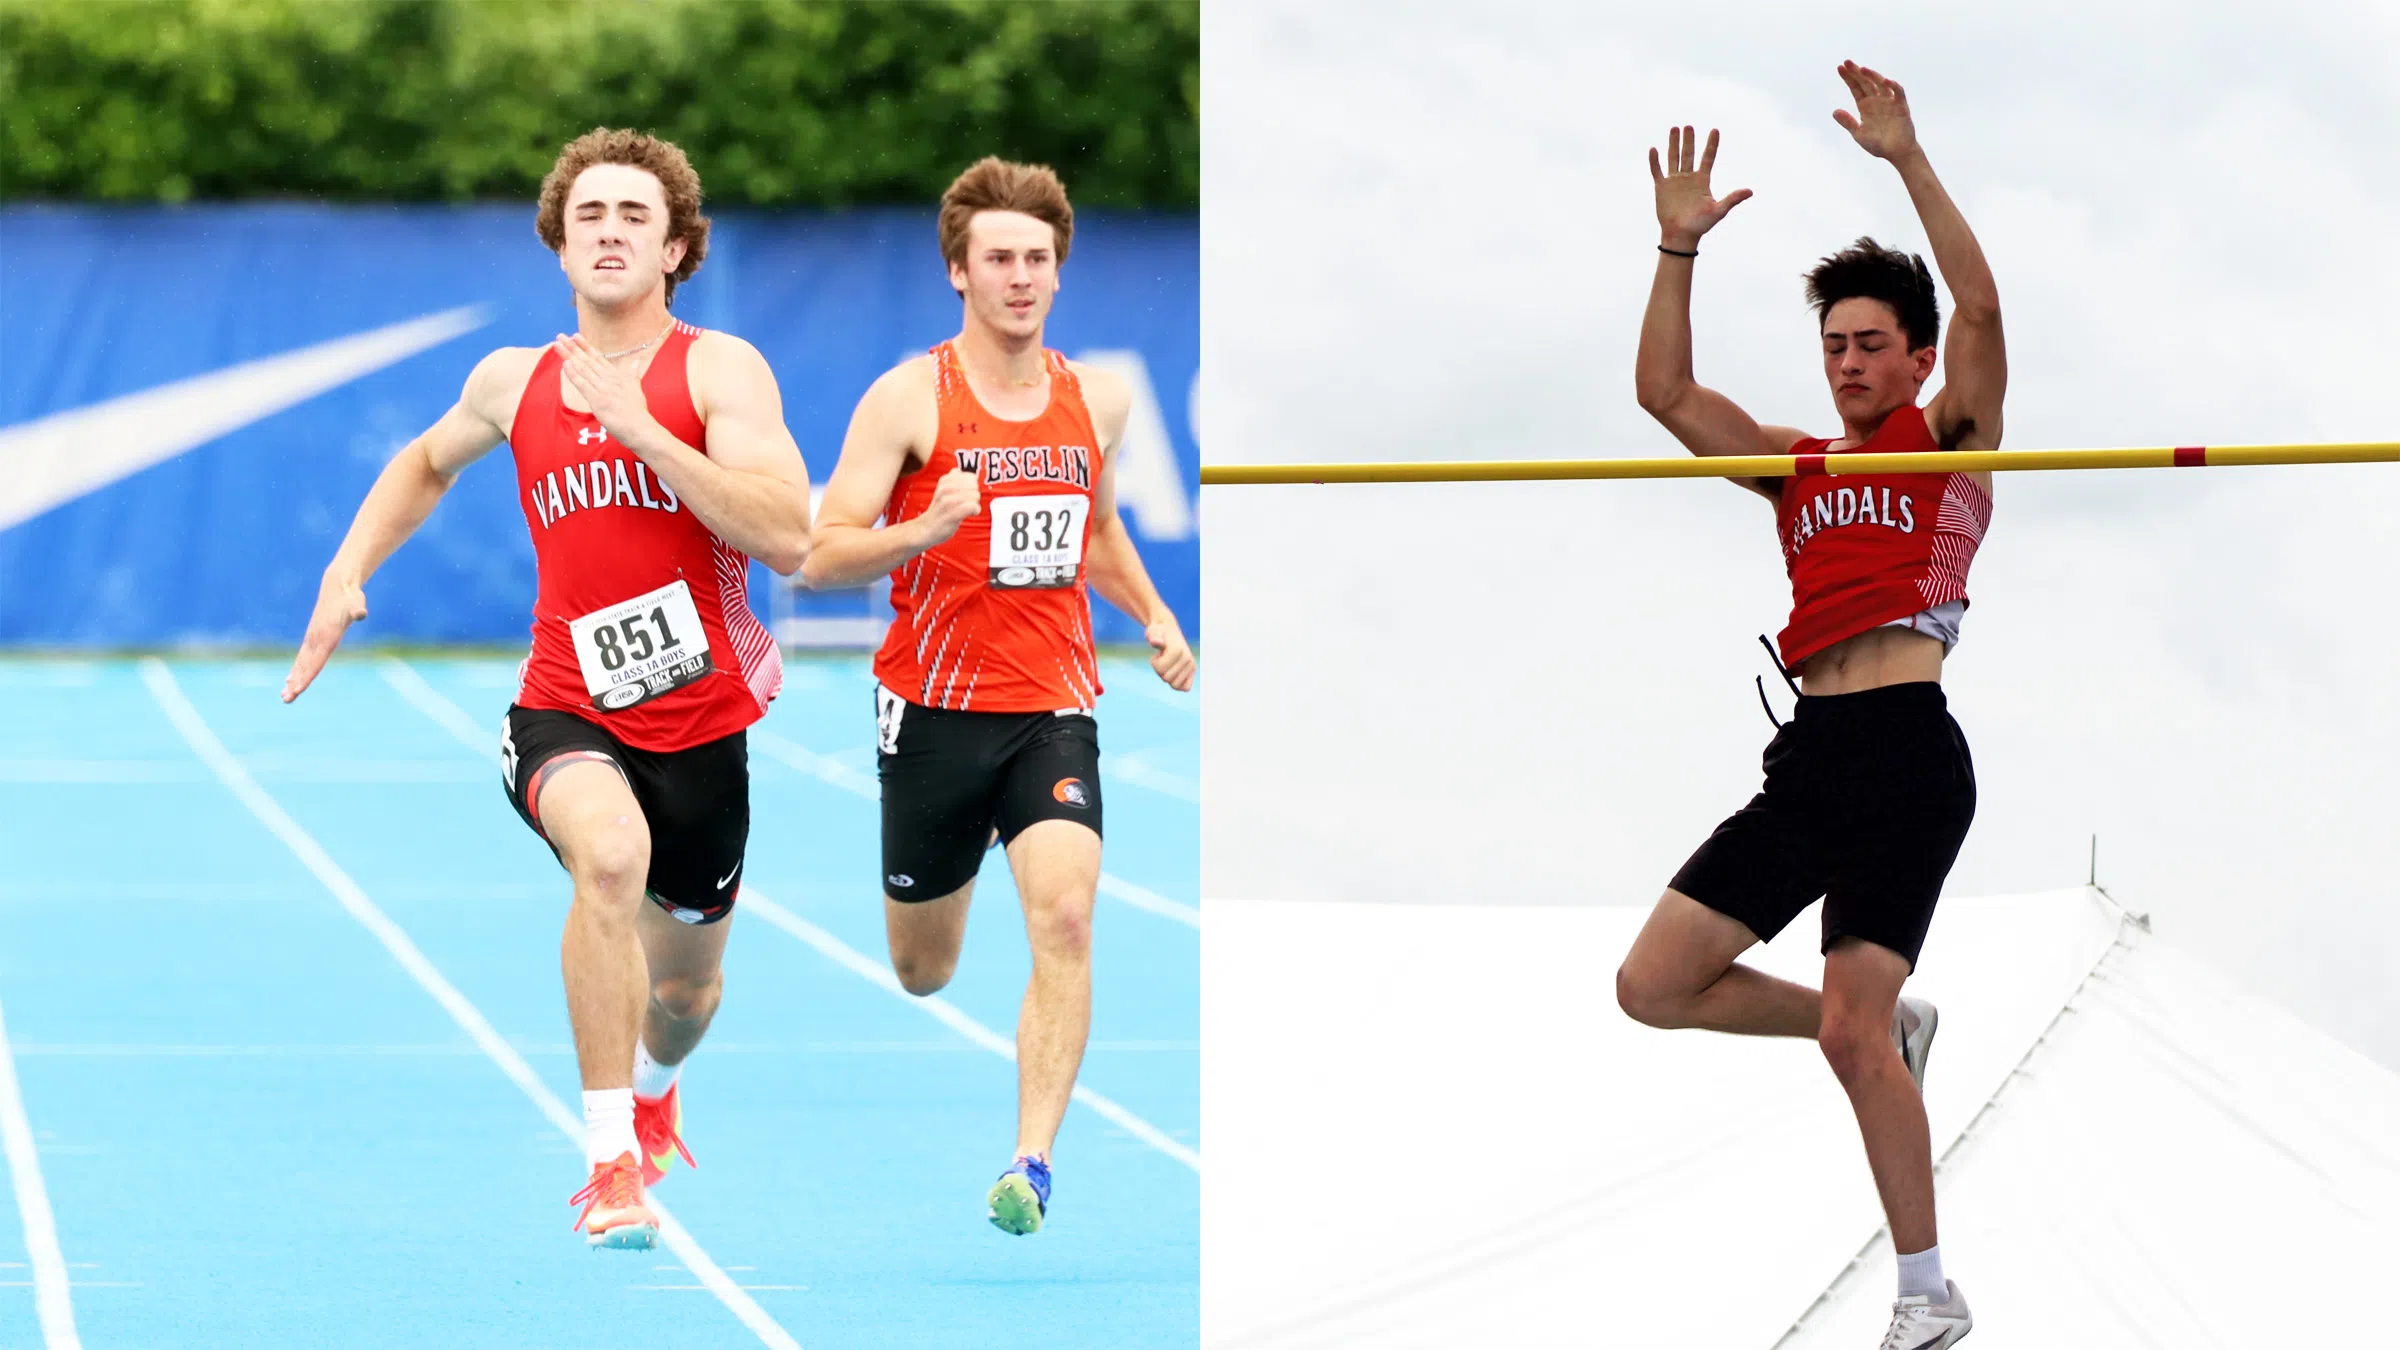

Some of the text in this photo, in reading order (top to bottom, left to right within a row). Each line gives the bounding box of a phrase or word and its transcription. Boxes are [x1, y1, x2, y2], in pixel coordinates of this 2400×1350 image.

[956, 446, 1090, 490] WESCLIN
[531, 458, 680, 530] VANDALS
[1010, 509, 1071, 552] 832
[593, 606, 681, 671] 851
[611, 648, 686, 685] CLASS 1A BOYS
[644, 668, 673, 690] TRACK
[680, 655, 705, 676] FIELD
